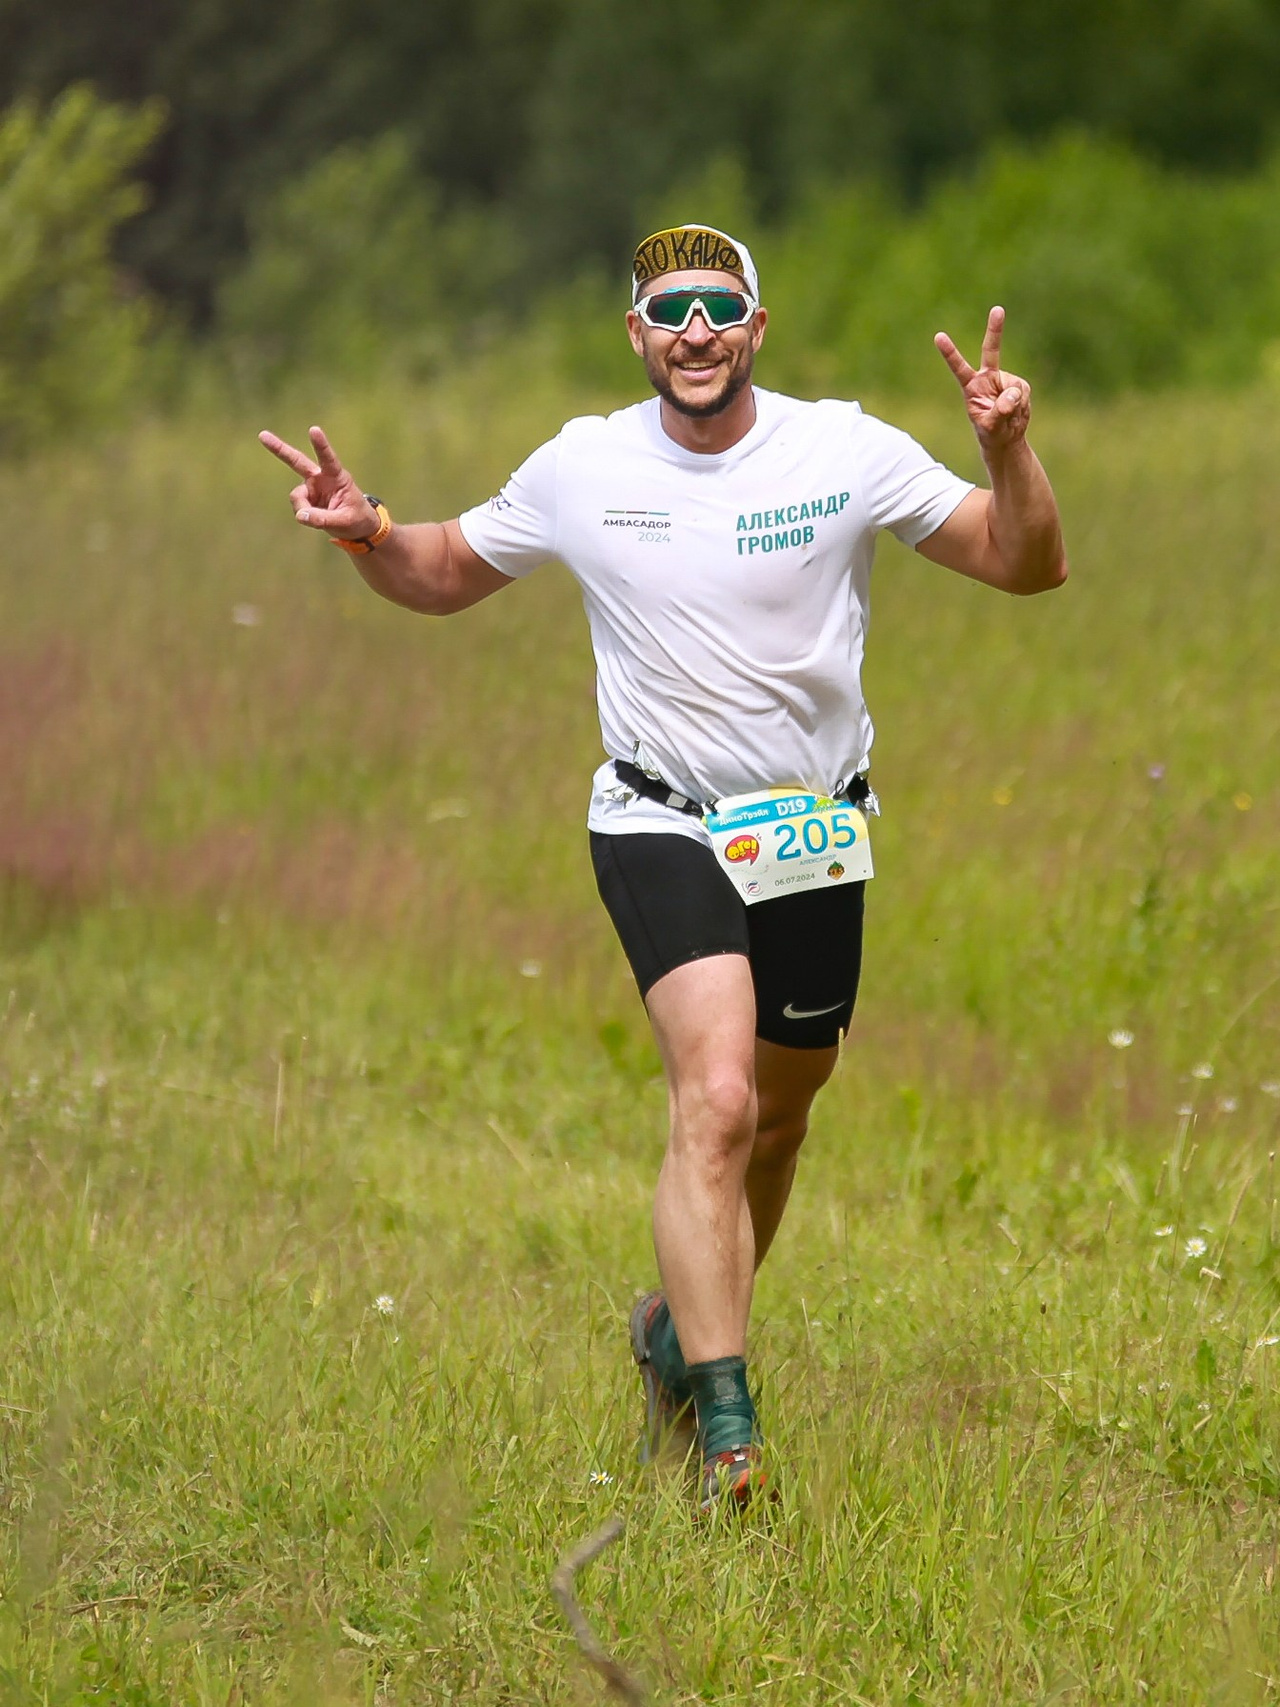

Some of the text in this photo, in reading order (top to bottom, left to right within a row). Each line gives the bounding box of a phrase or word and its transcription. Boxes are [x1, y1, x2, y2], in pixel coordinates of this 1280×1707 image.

[633, 238, 669, 281] ЭТО
[602, 518, 672, 530] АМБАСАДОР
[736, 491, 851, 532] АЛЕКСАНДР
[638, 531, 671, 543] 2024
[737, 525, 815, 556] ГРОМОВ
[719, 797, 807, 826] ДиноТрэйл D19
[774, 813, 857, 862] 205
[774, 872, 816, 887] 06.07.2024
